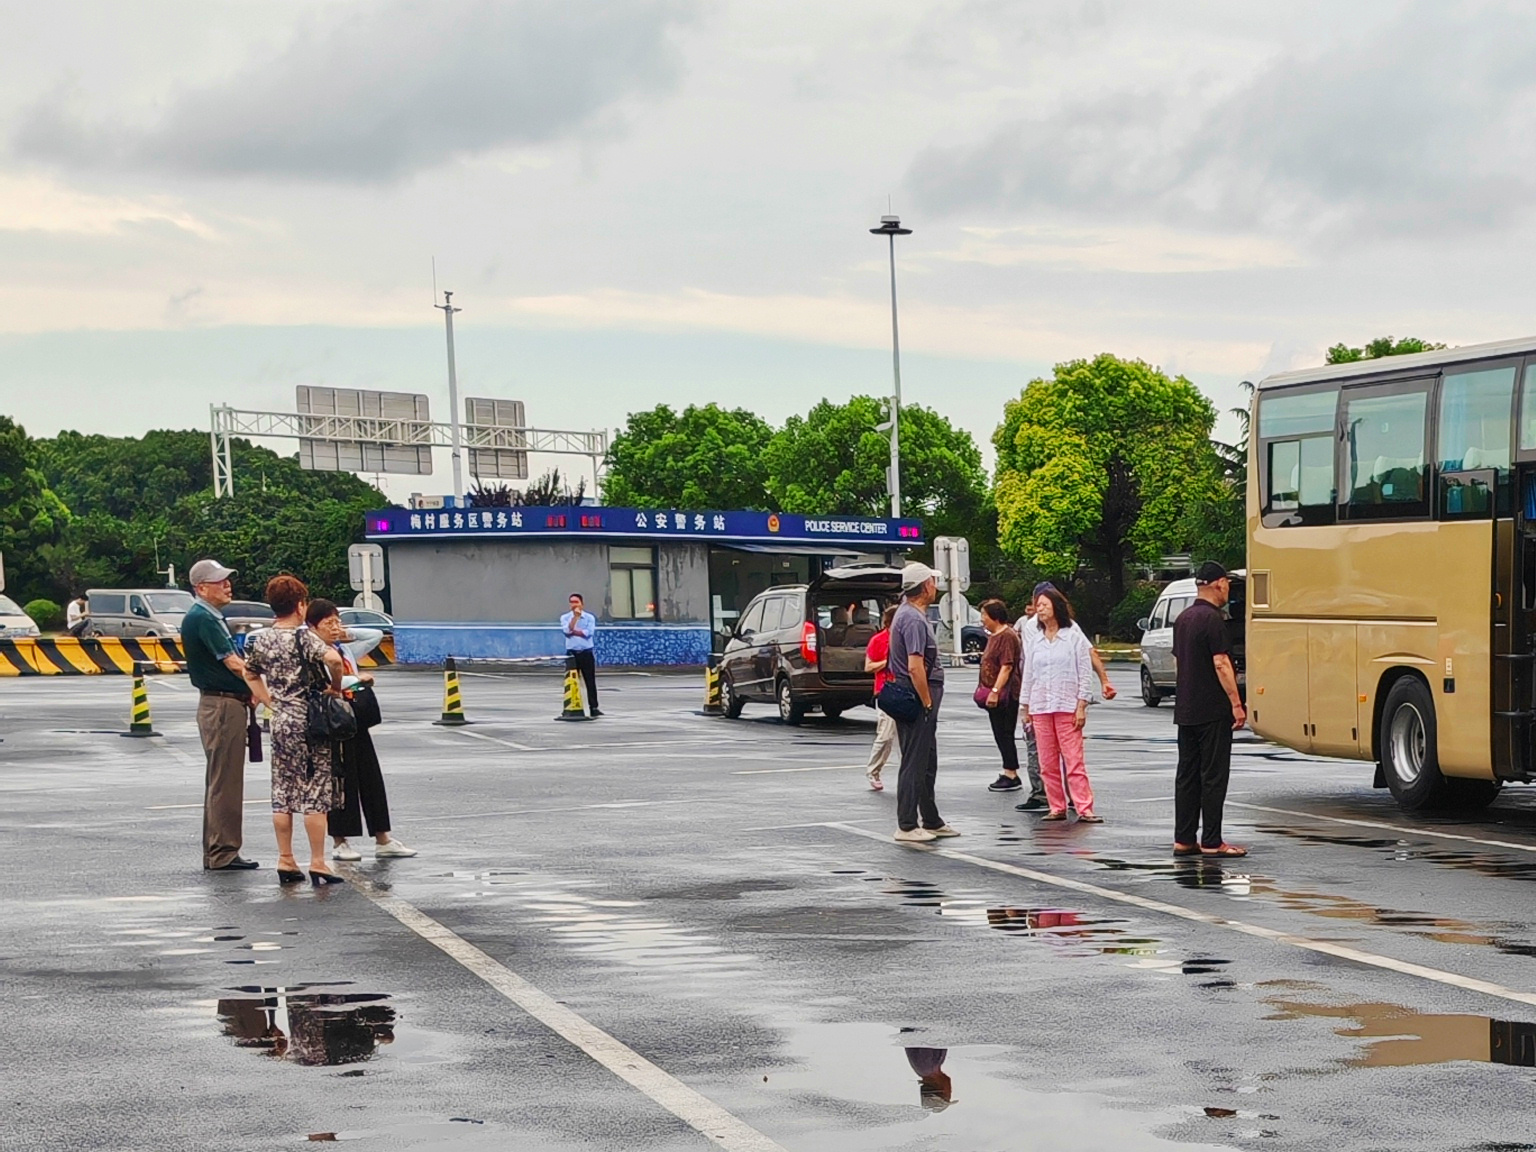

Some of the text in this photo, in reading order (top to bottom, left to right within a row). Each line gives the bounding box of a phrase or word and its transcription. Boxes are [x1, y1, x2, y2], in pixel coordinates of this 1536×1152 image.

[410, 512, 523, 530] 梅村服务区警务站
[635, 512, 726, 531] 公安警务站
[805, 520, 888, 534] POLICE SERVICE CENTER
